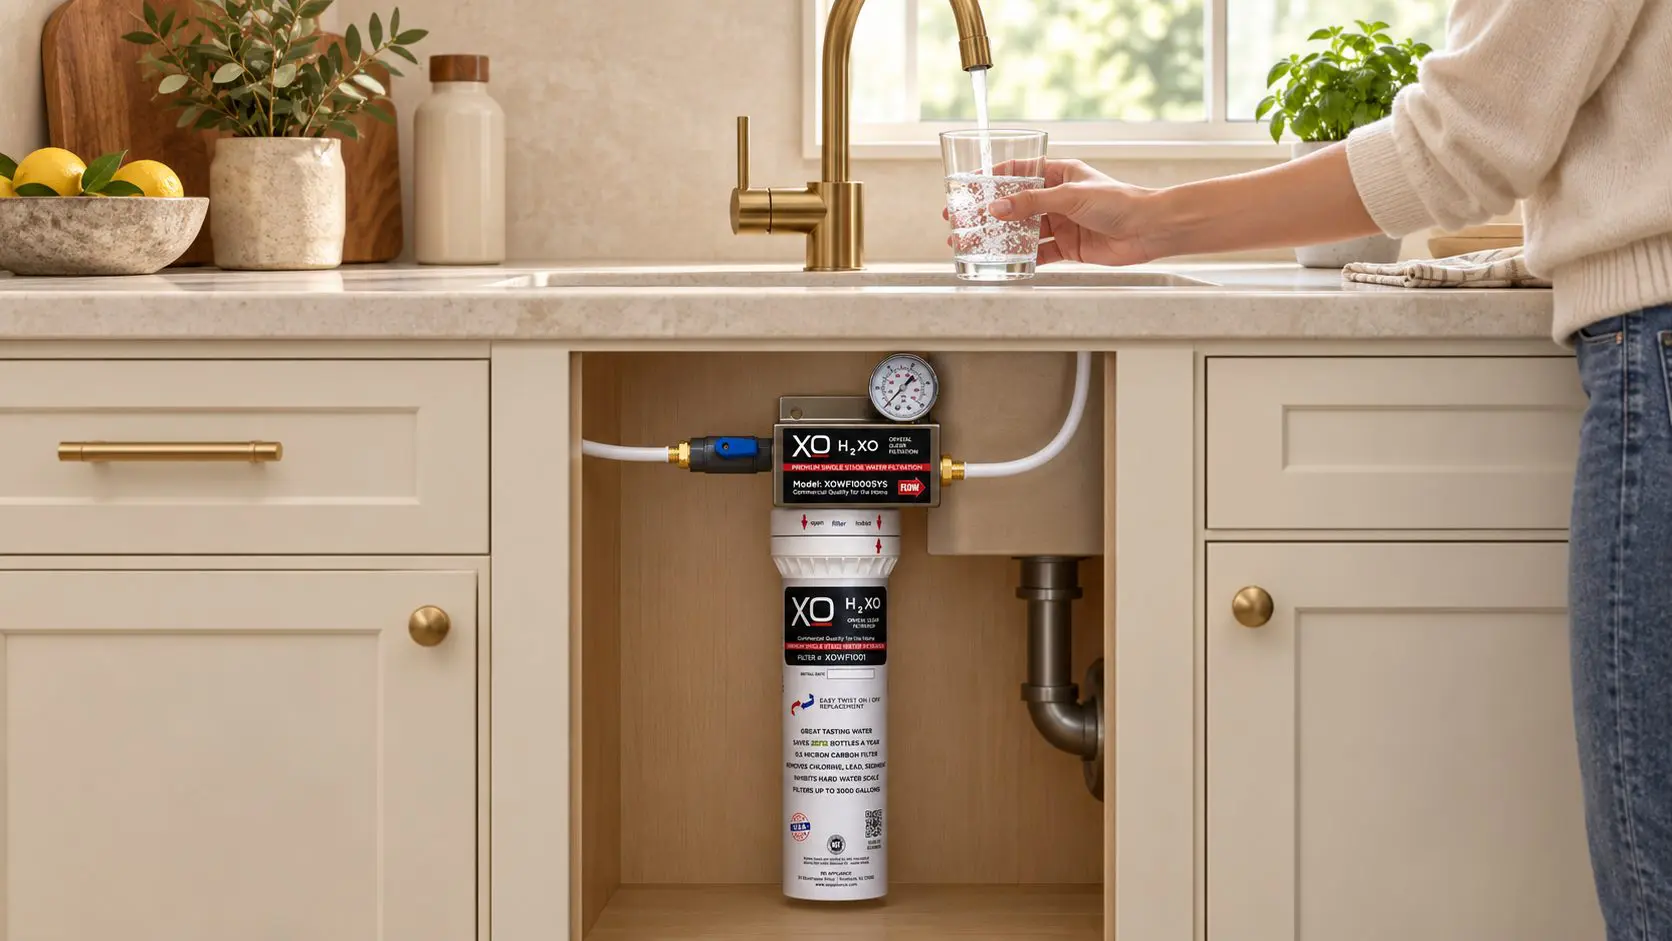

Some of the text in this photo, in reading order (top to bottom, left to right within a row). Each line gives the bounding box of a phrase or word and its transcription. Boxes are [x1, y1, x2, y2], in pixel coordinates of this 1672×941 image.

[792, 435, 831, 458] XO
[793, 480, 823, 488] Model:
[900, 483, 920, 492] FLOW
[791, 597, 835, 627] XO
[825, 653, 866, 661] XOWF1001
[792, 786, 814, 794] FILTERS
